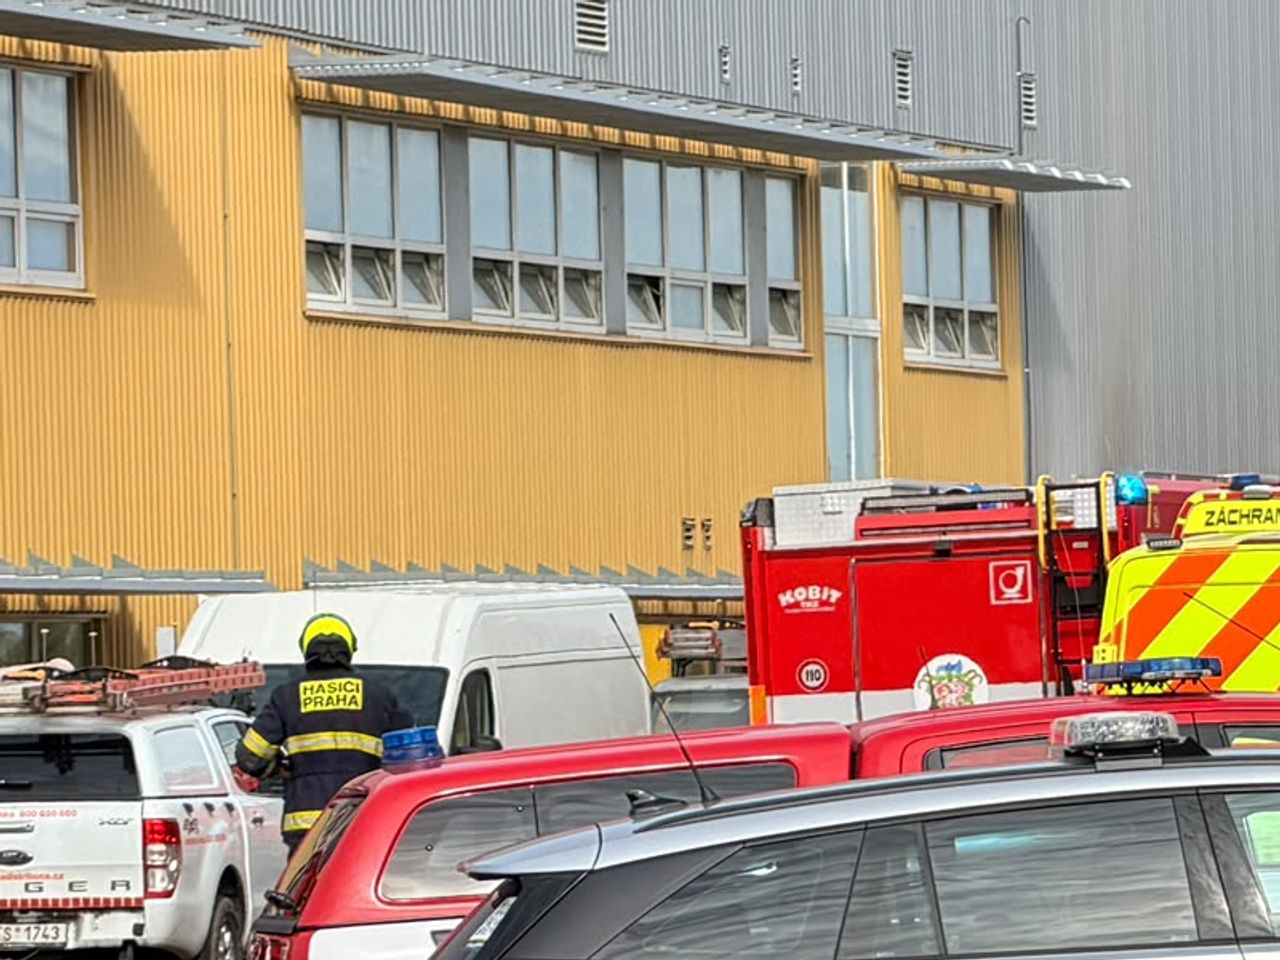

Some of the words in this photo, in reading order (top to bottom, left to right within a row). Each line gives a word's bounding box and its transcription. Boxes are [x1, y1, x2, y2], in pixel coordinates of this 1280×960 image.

[778, 585, 843, 607] KOBIT
[303, 694, 359, 710] PRAHA
[25, 926, 60, 940] 1743
